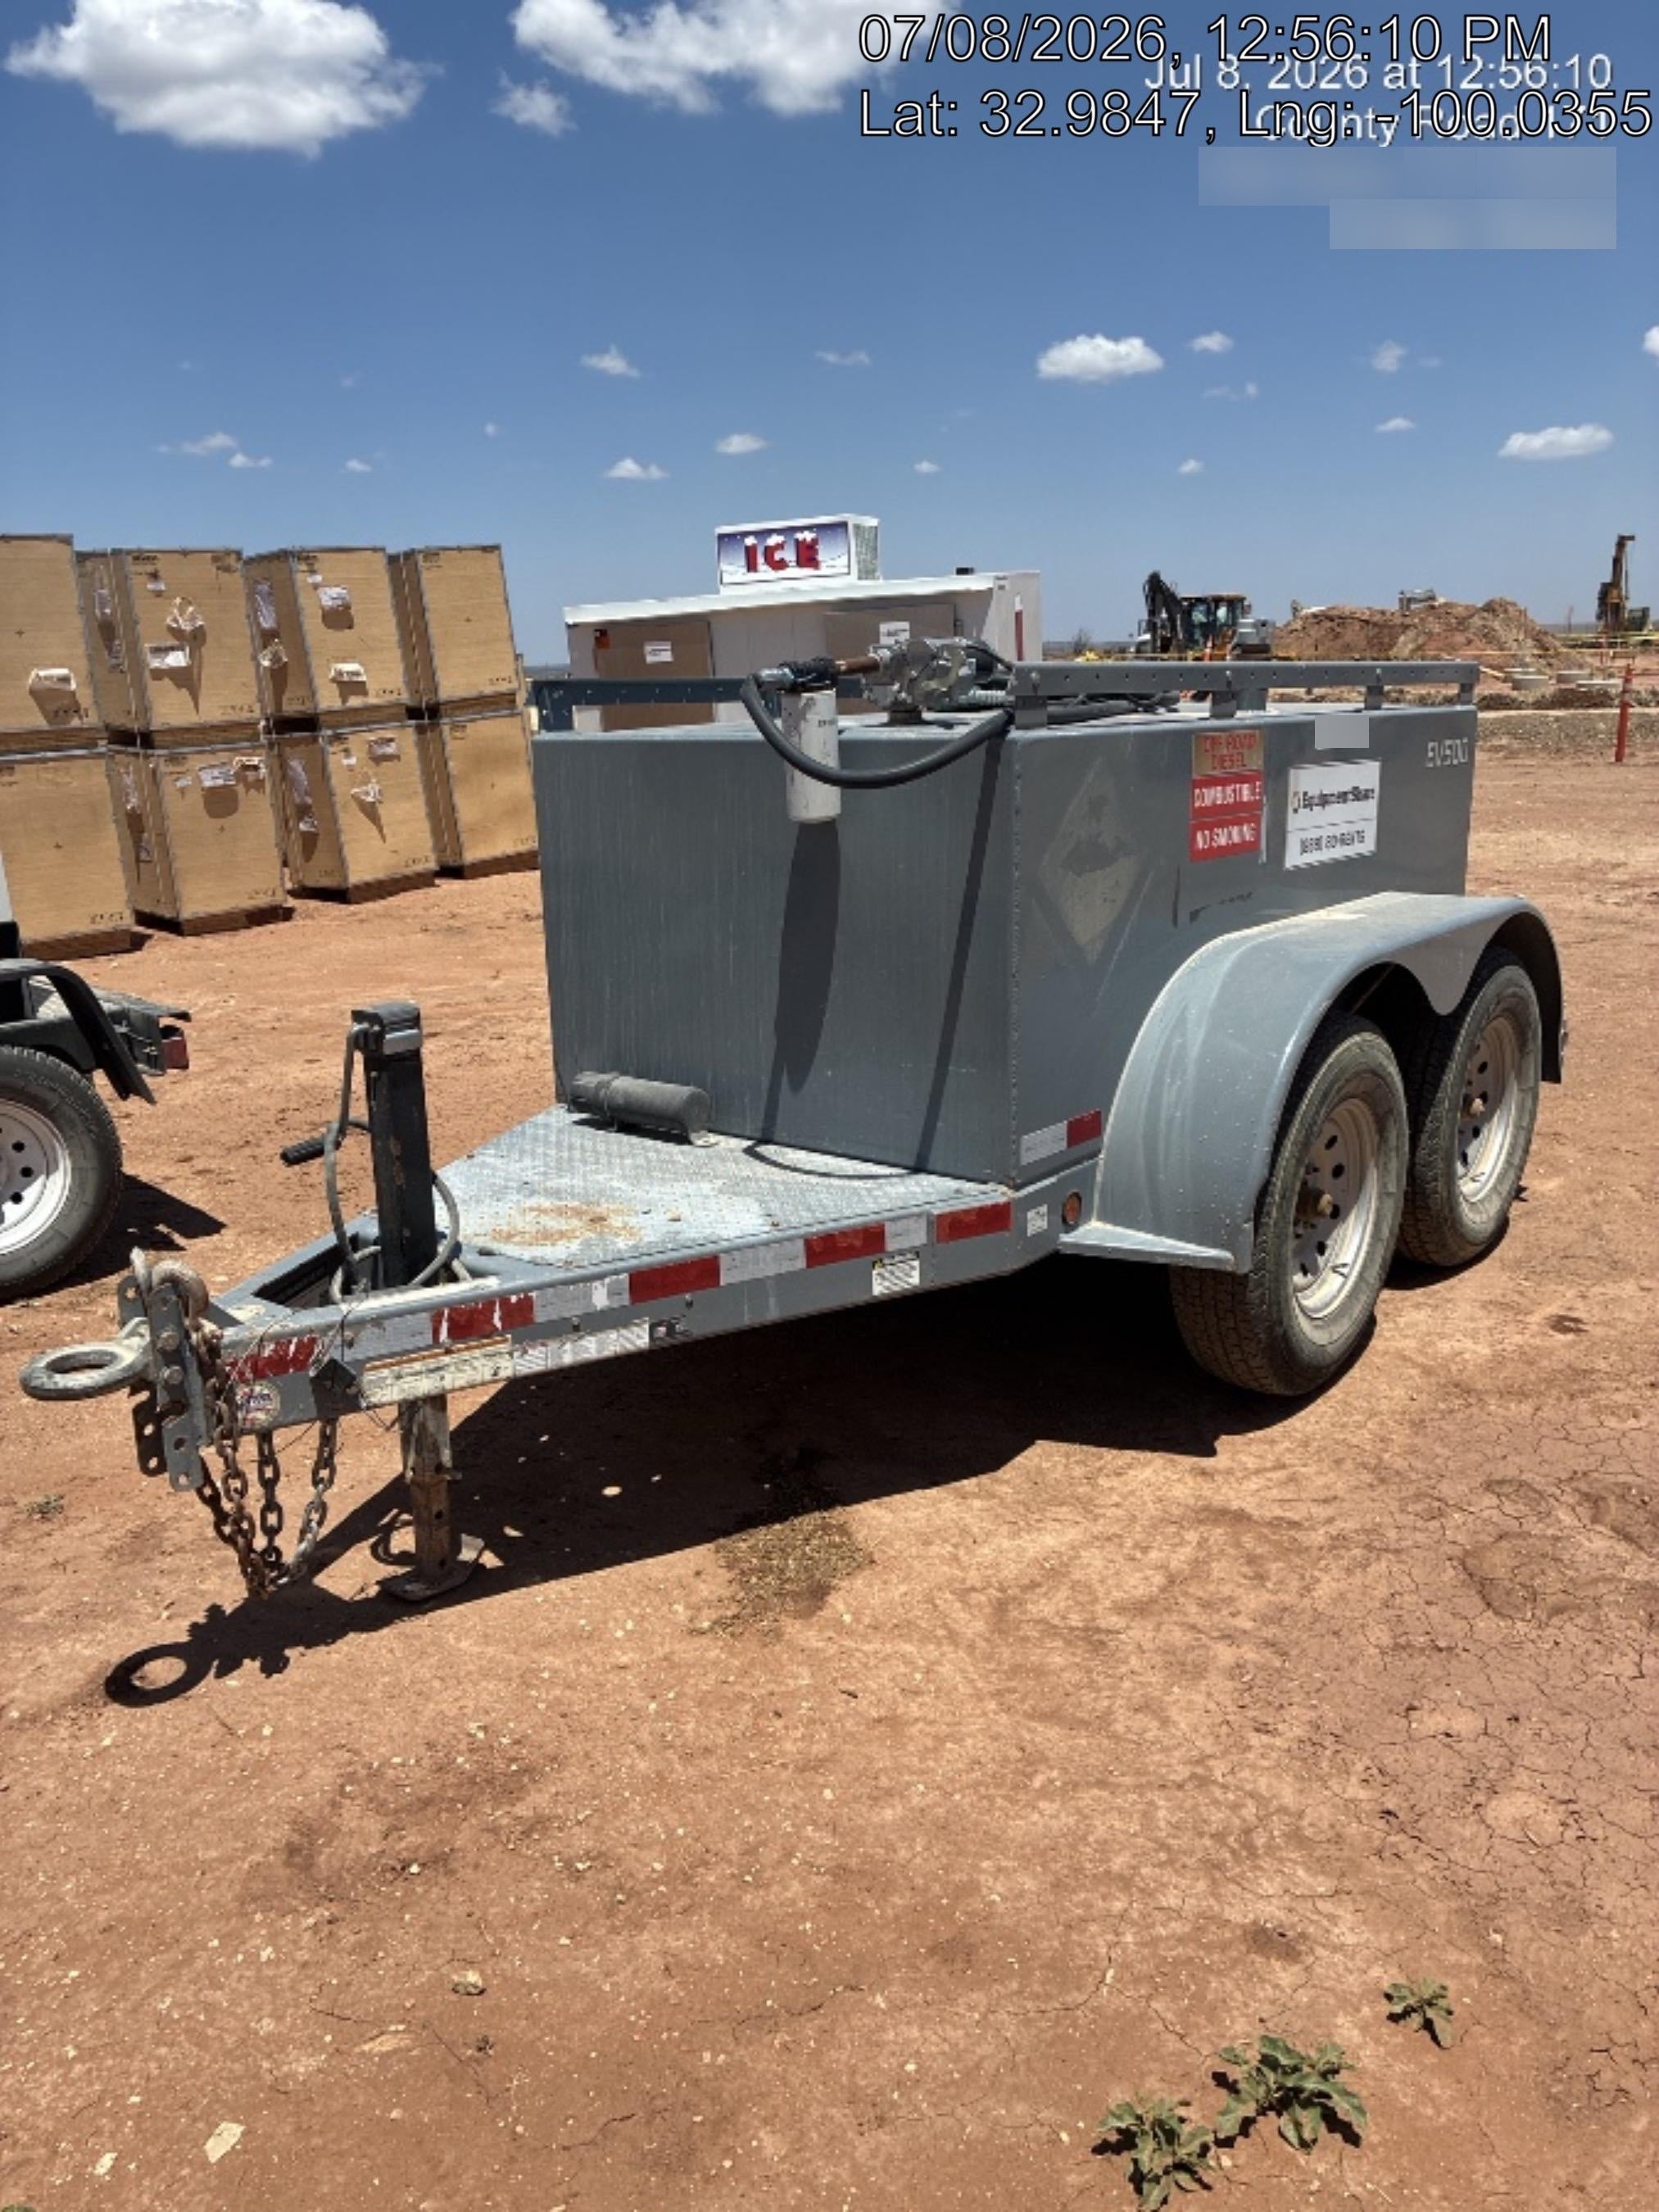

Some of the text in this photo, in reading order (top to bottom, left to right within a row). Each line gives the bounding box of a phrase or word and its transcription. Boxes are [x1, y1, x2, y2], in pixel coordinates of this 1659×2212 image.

[743, 530, 820, 573] ICE
[1193, 781, 1262, 809] COMBUSTIBLE
[1196, 823, 1258, 851] NO SMOKING
